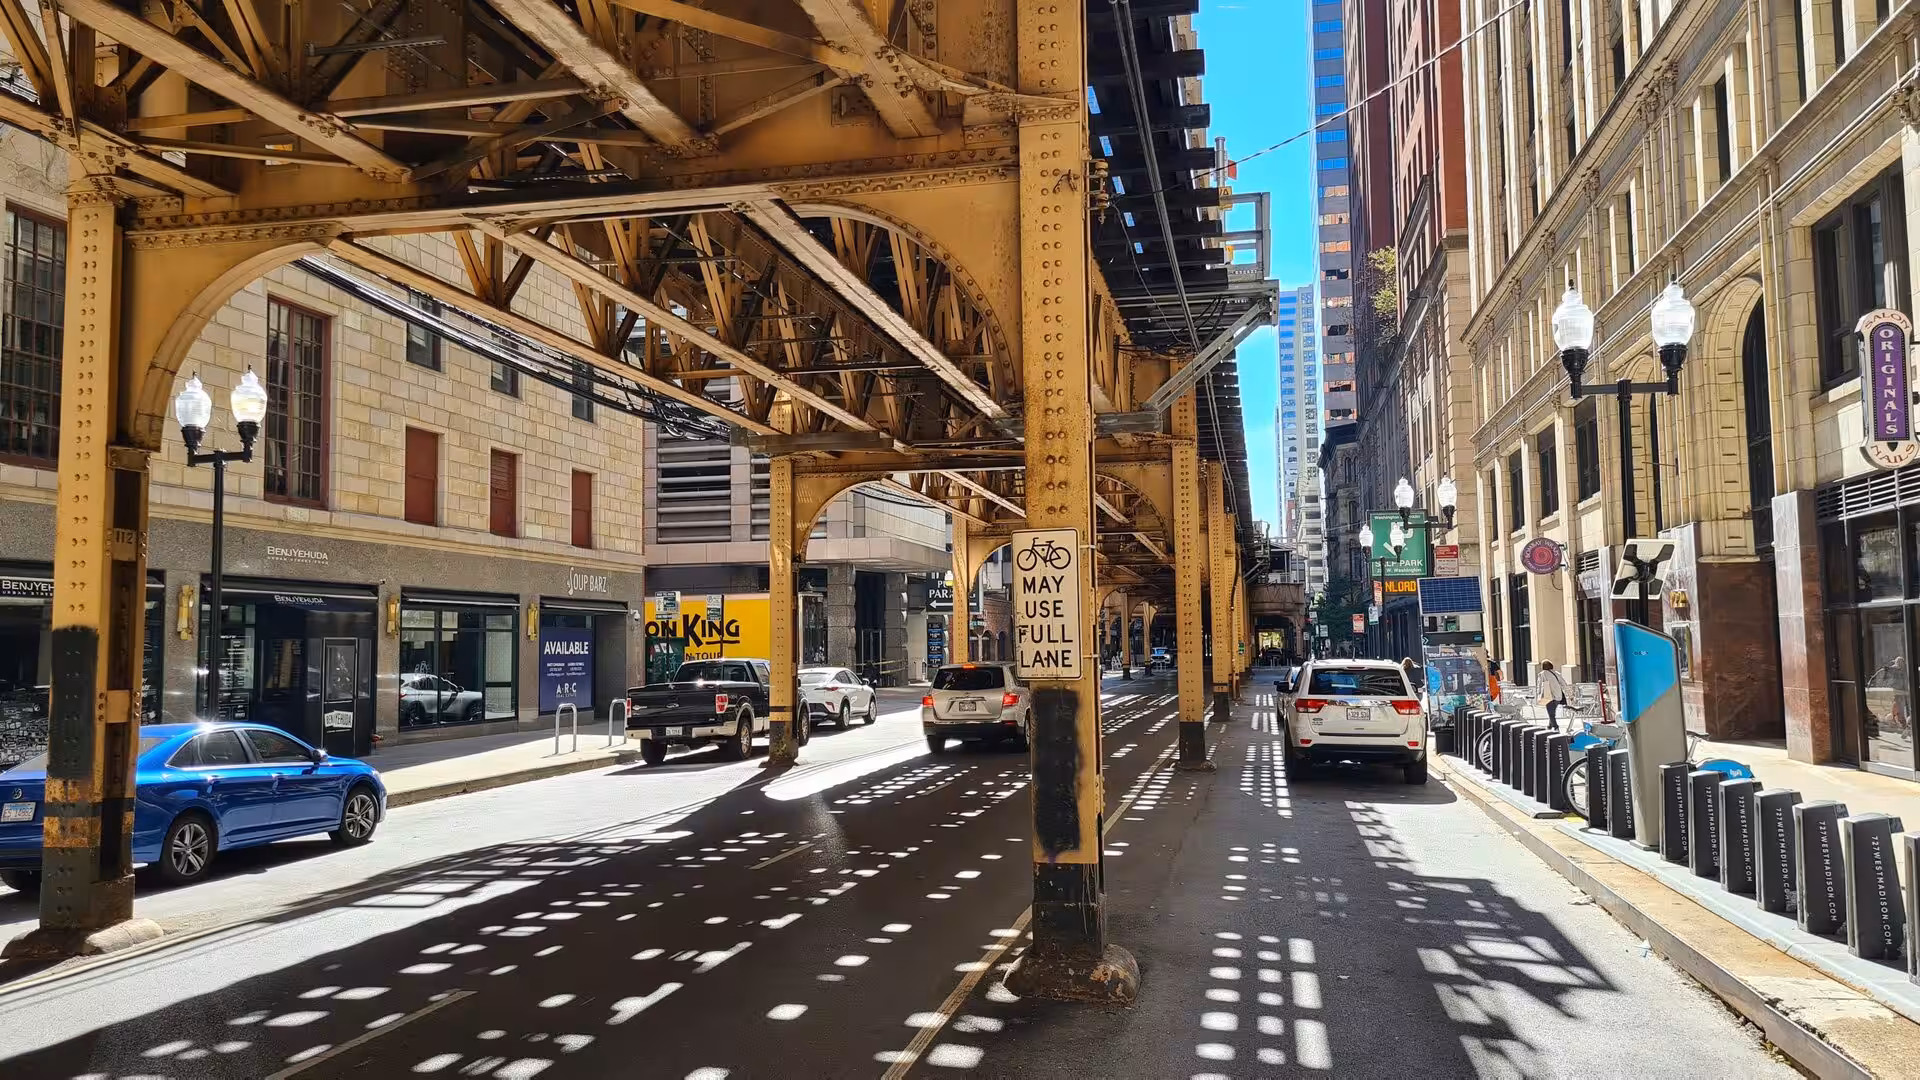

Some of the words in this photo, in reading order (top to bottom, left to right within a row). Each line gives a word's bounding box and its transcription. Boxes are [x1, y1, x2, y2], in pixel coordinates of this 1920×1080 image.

[1864, 312, 1911, 331] SALON
[1879, 329, 1899, 435] ORIGINALS
[1870, 443, 1916, 465] NAILS
[1375, 559, 1398, 567] SLF
[1400, 559, 1424, 567] PARK
[589, 575, 607, 593] BARZ
[1022, 575, 1065, 594] MAY
[1025, 599, 1064, 618] USE
[682, 613, 740, 648] KING
[1018, 624, 1074, 644] FULL
[543, 640, 590, 655] AVAILABLE
[1020, 649, 1073, 668] LANE
[1738, 796, 1753, 882] 727WESTMADISON.COM
[1819, 820, 1837, 921] 727WESTMADISON.COM
[1871, 835, 1893, 946] 727WESTMADISON.COM
